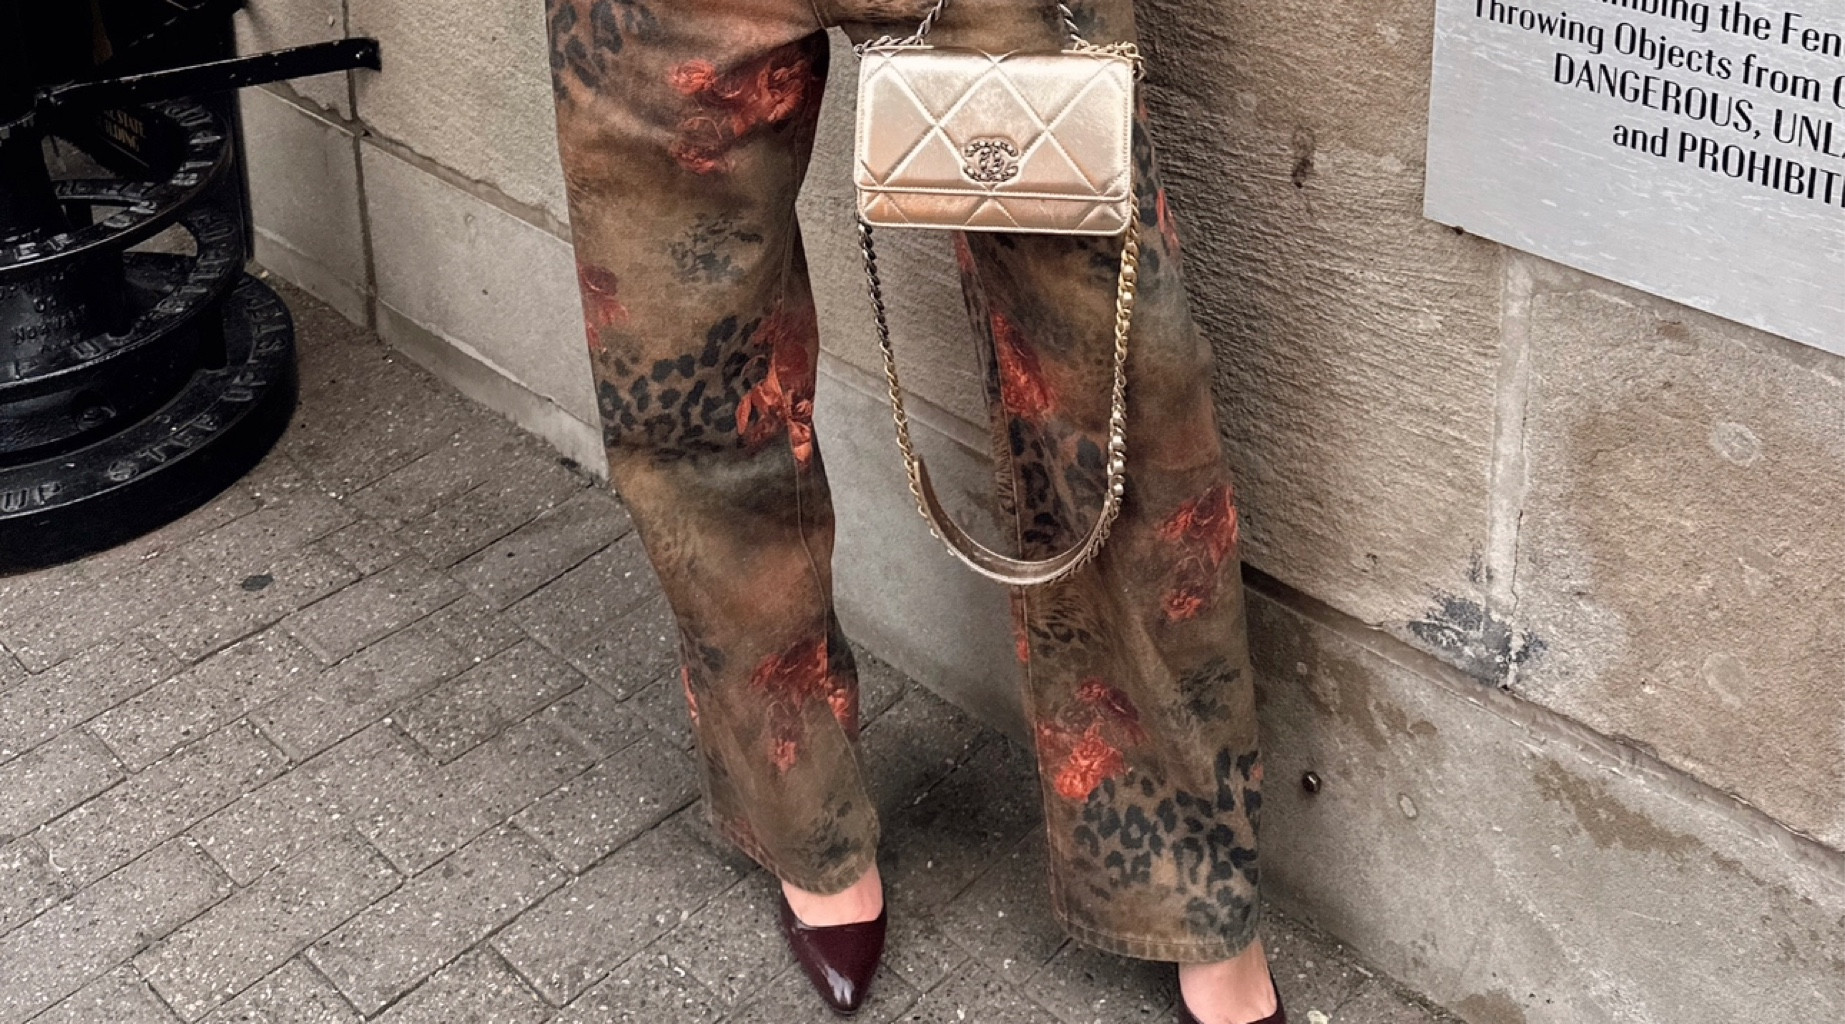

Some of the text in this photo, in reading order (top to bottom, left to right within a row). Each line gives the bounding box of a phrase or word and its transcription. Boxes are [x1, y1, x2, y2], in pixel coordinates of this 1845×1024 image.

[1614, 22, 1733, 81] Objects
[1742, 53, 1820, 103] from
[1720, 0, 1771, 41] the
[1781, 12, 1845, 59] Fen
[1554, 52, 1845, 158] DANGEROUS, UNL
[1612, 125, 1669, 158] and
